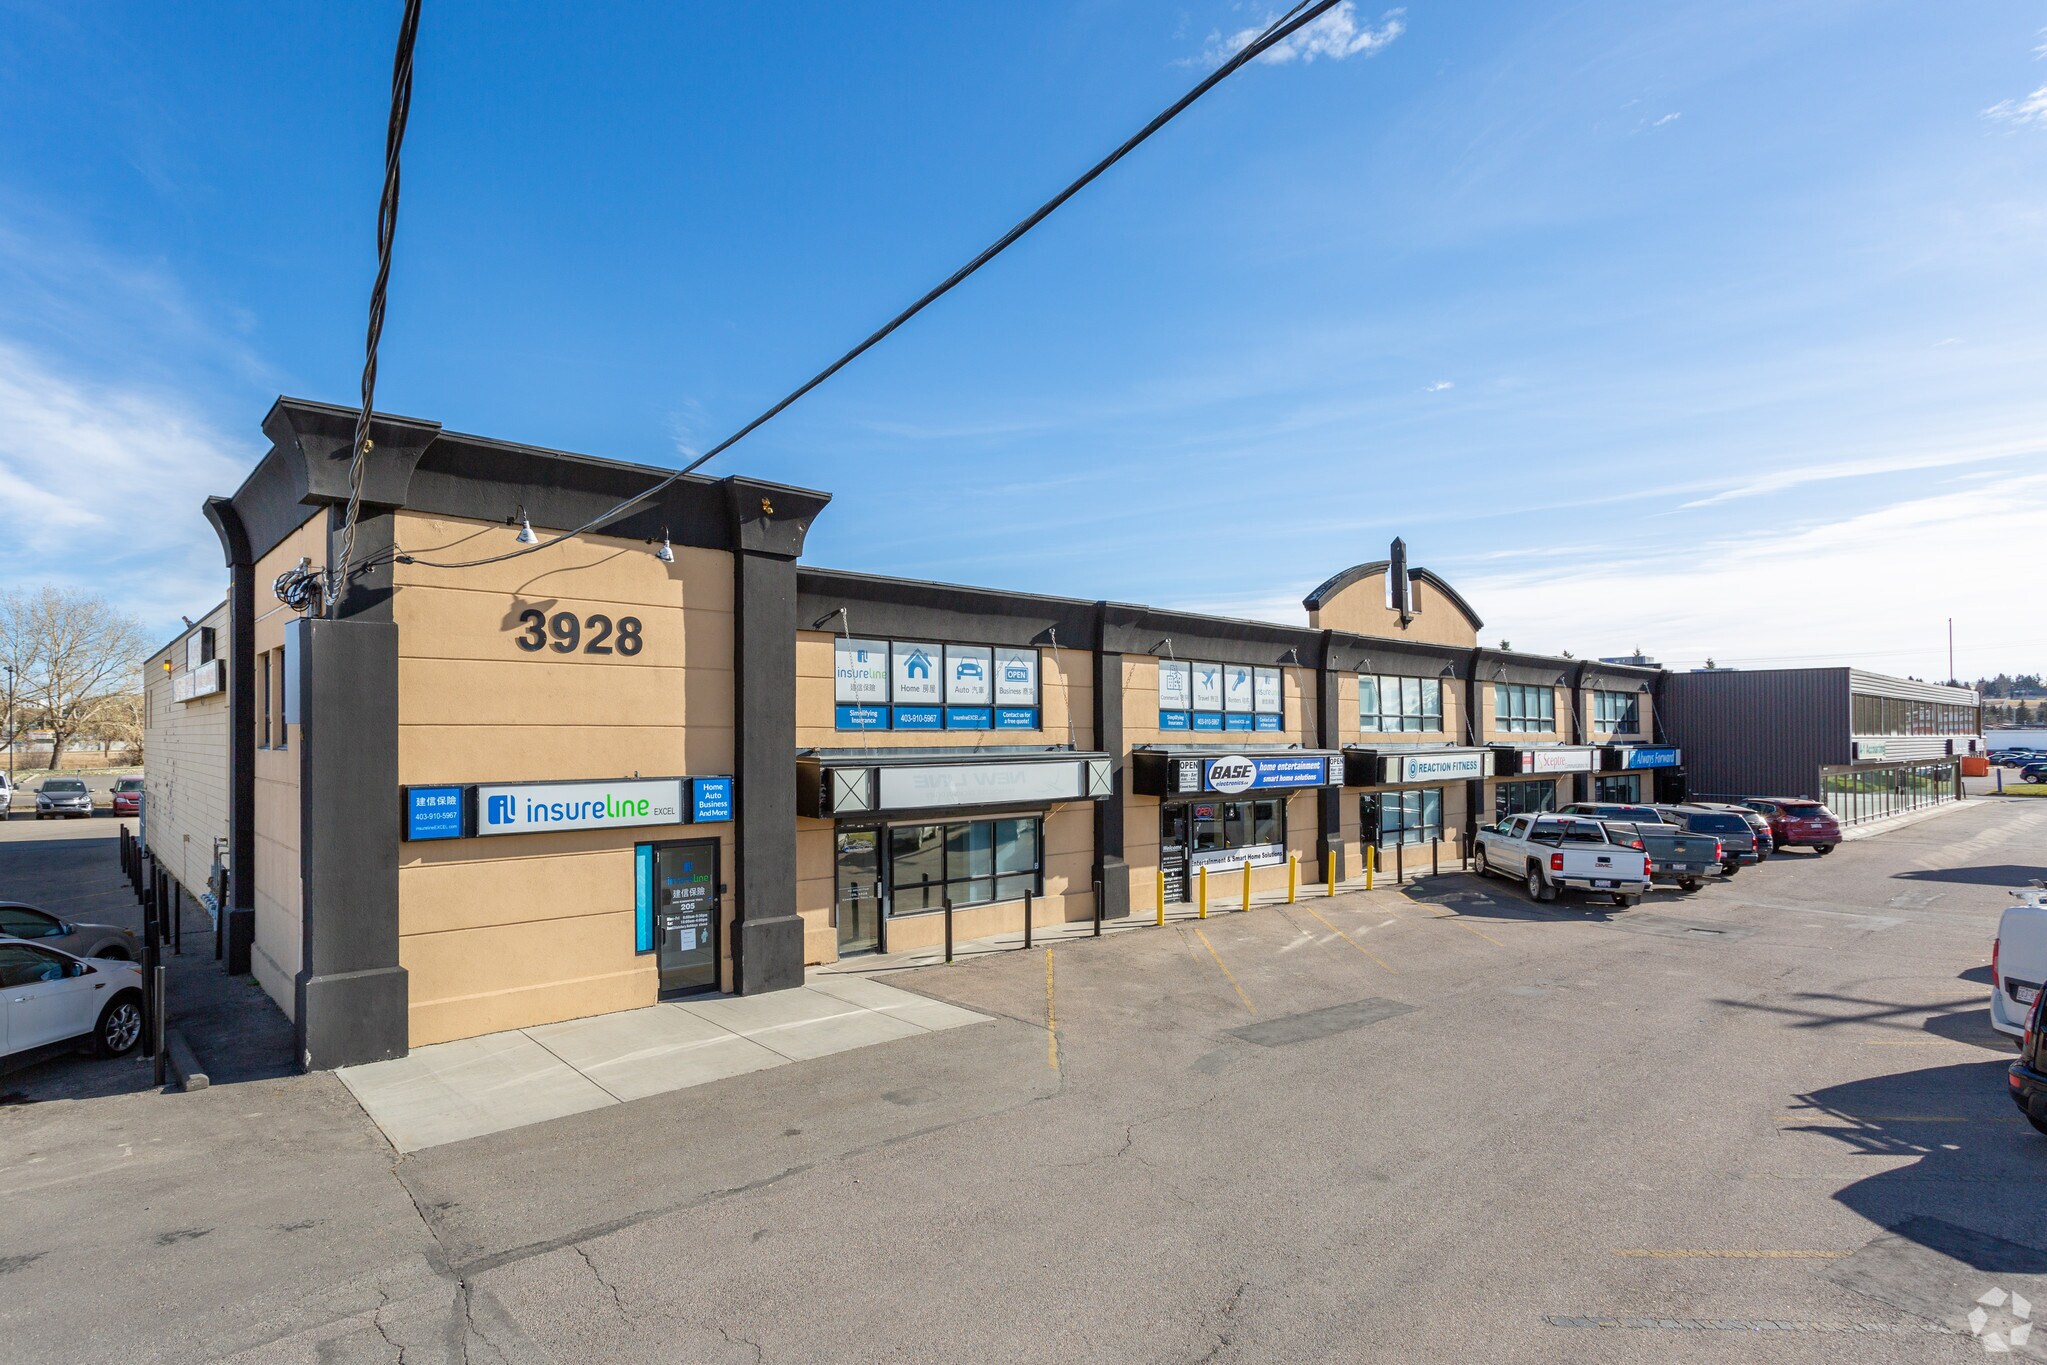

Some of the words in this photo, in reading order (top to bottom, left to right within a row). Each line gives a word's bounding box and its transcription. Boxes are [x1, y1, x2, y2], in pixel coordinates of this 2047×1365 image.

[518, 609, 643, 656] 3928
[1008, 671, 1026, 679] OPEN
[900, 684, 920, 692] Home
[954, 686, 970, 694] Auto
[999, 687, 1022, 695] Business
[1330, 757, 1344, 765] OPEN
[1637, 752, 1654, 766] Always
[1654, 750, 1675, 764] Forward
[1180, 761, 1198, 769] OPEN
[1259, 761, 1277, 771] home
[1277, 760, 1320, 771] entertainment
[1418, 762, 1451, 773] REACTION
[1452, 760, 1478, 771] FITNESS
[1210, 765, 1253, 780] BASE
[1279, 774, 1294, 782] home
[1294, 773, 1317, 781] solutions
[703, 783, 723, 791] Home
[705, 792, 722, 800] Auto
[527, 794, 649, 823] insureline
[654, 807, 676, 816] EXCEL
[698, 800, 728, 809] Business
[415, 811, 458, 820] 403-910-5967
[712, 809, 728, 817] More
[1231, 855, 1247, 863] Smart
[1261, 851, 1283, 859] Solutions
[680, 902, 696, 911] 205
